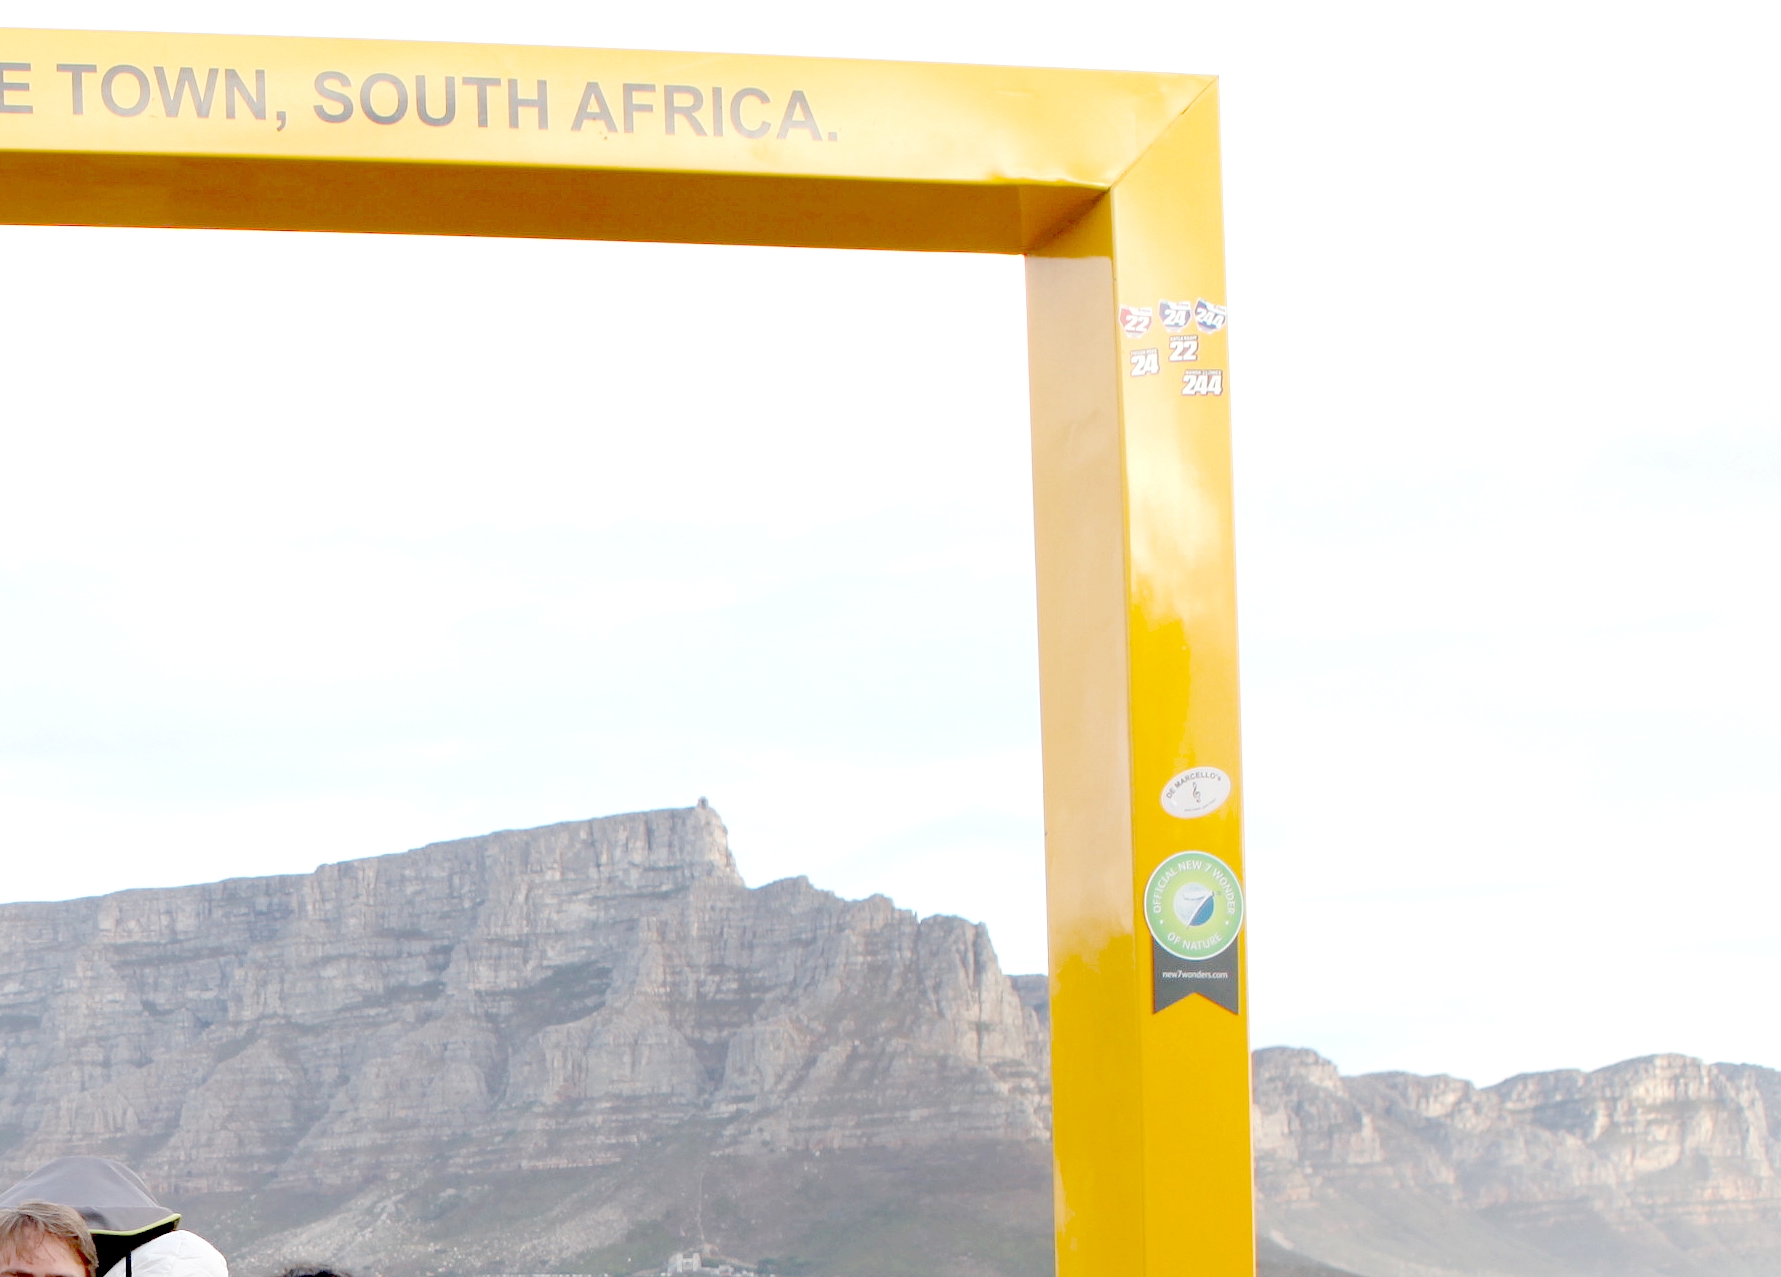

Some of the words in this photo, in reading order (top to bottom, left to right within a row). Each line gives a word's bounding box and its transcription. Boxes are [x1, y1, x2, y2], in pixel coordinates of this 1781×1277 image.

[56, 62, 288, 133] TOWN,
[312, 70, 549, 131] SOUTH
[570, 80, 840, 142] AFRICA.
[1124, 314, 1151, 333] 22
[1163, 308, 1187, 328] 24
[1169, 339, 1198, 362] 22
[1130, 353, 1159, 377] 24
[1182, 374, 1223, 396] 244
[1153, 868, 1177, 914] OFFICIAL
[1177, 859, 1203, 872] NEW
[1204, 862, 1213, 873] 7
[1213, 870, 1236, 915] WONDER
[1167, 932, 1182, 944] OF
[1182, 932, 1223, 950] NATURE
[1162, 969, 1228, 980] new7wonders.com
